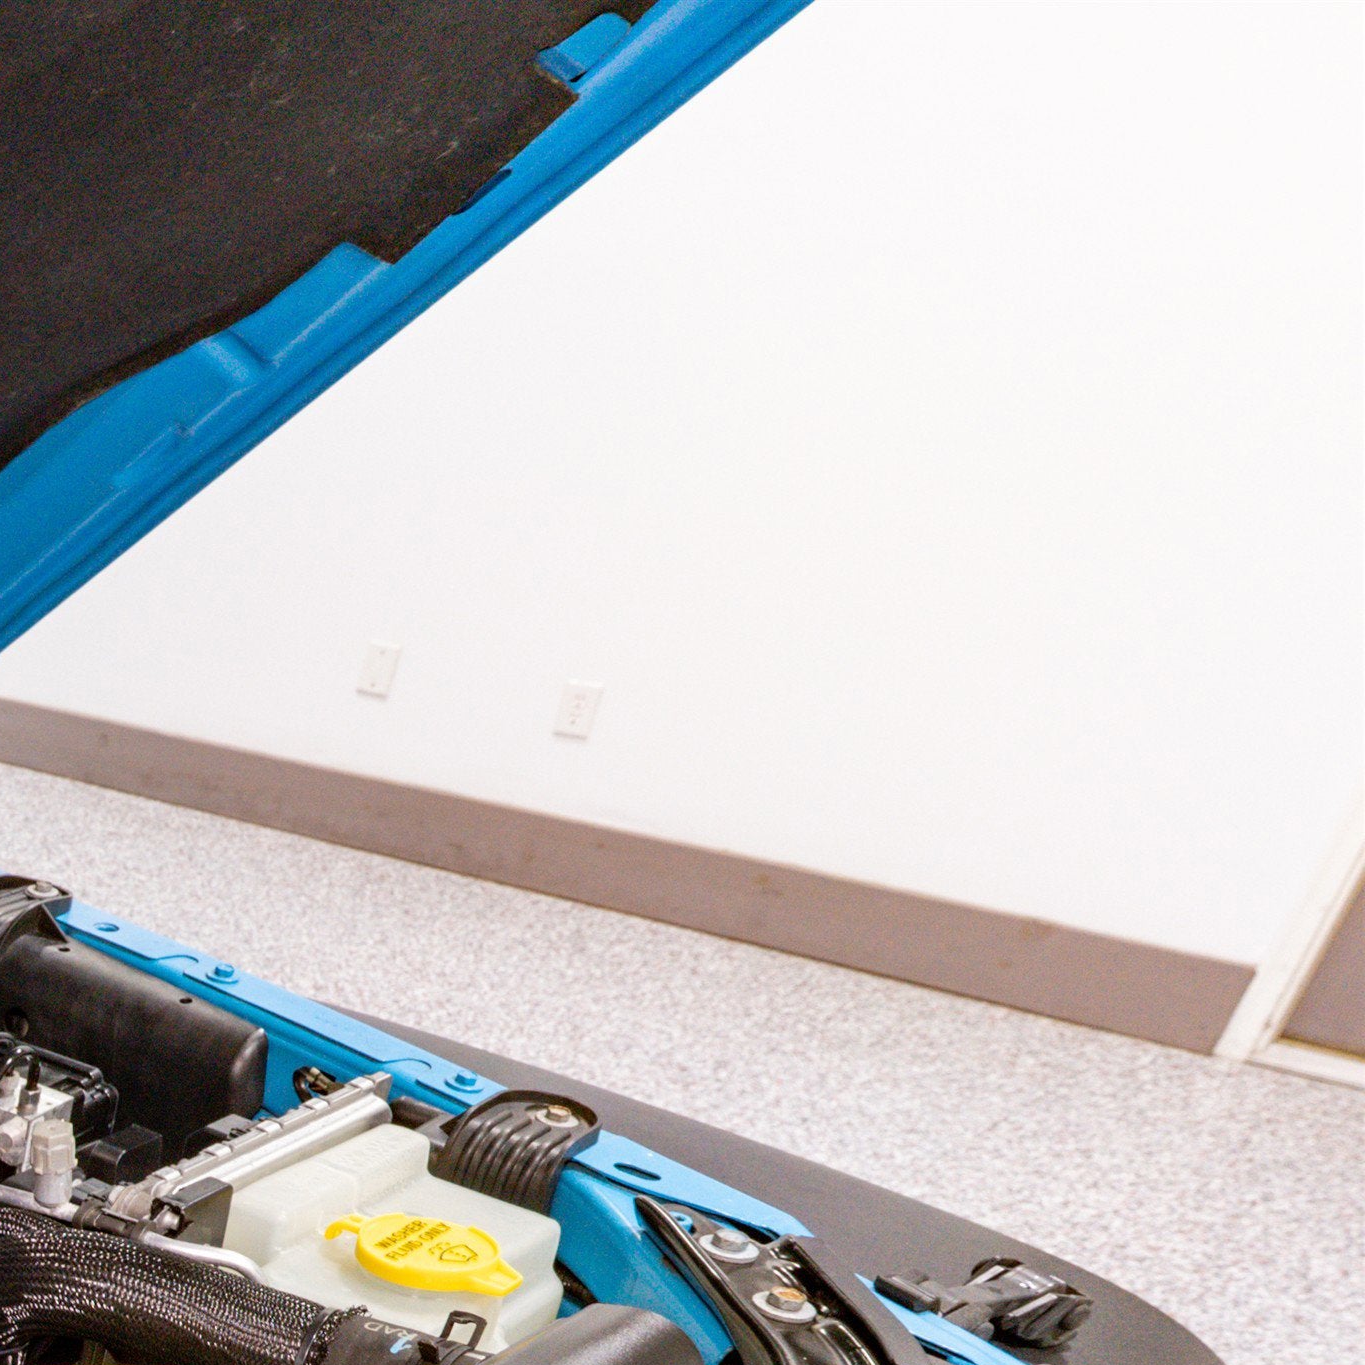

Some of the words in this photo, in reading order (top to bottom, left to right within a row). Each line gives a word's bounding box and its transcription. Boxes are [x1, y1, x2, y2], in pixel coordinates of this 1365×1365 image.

[374, 1220, 427, 1248] WASHER
[385, 1241, 423, 1261] FLUID
[419, 1222, 451, 1241] ONLY
